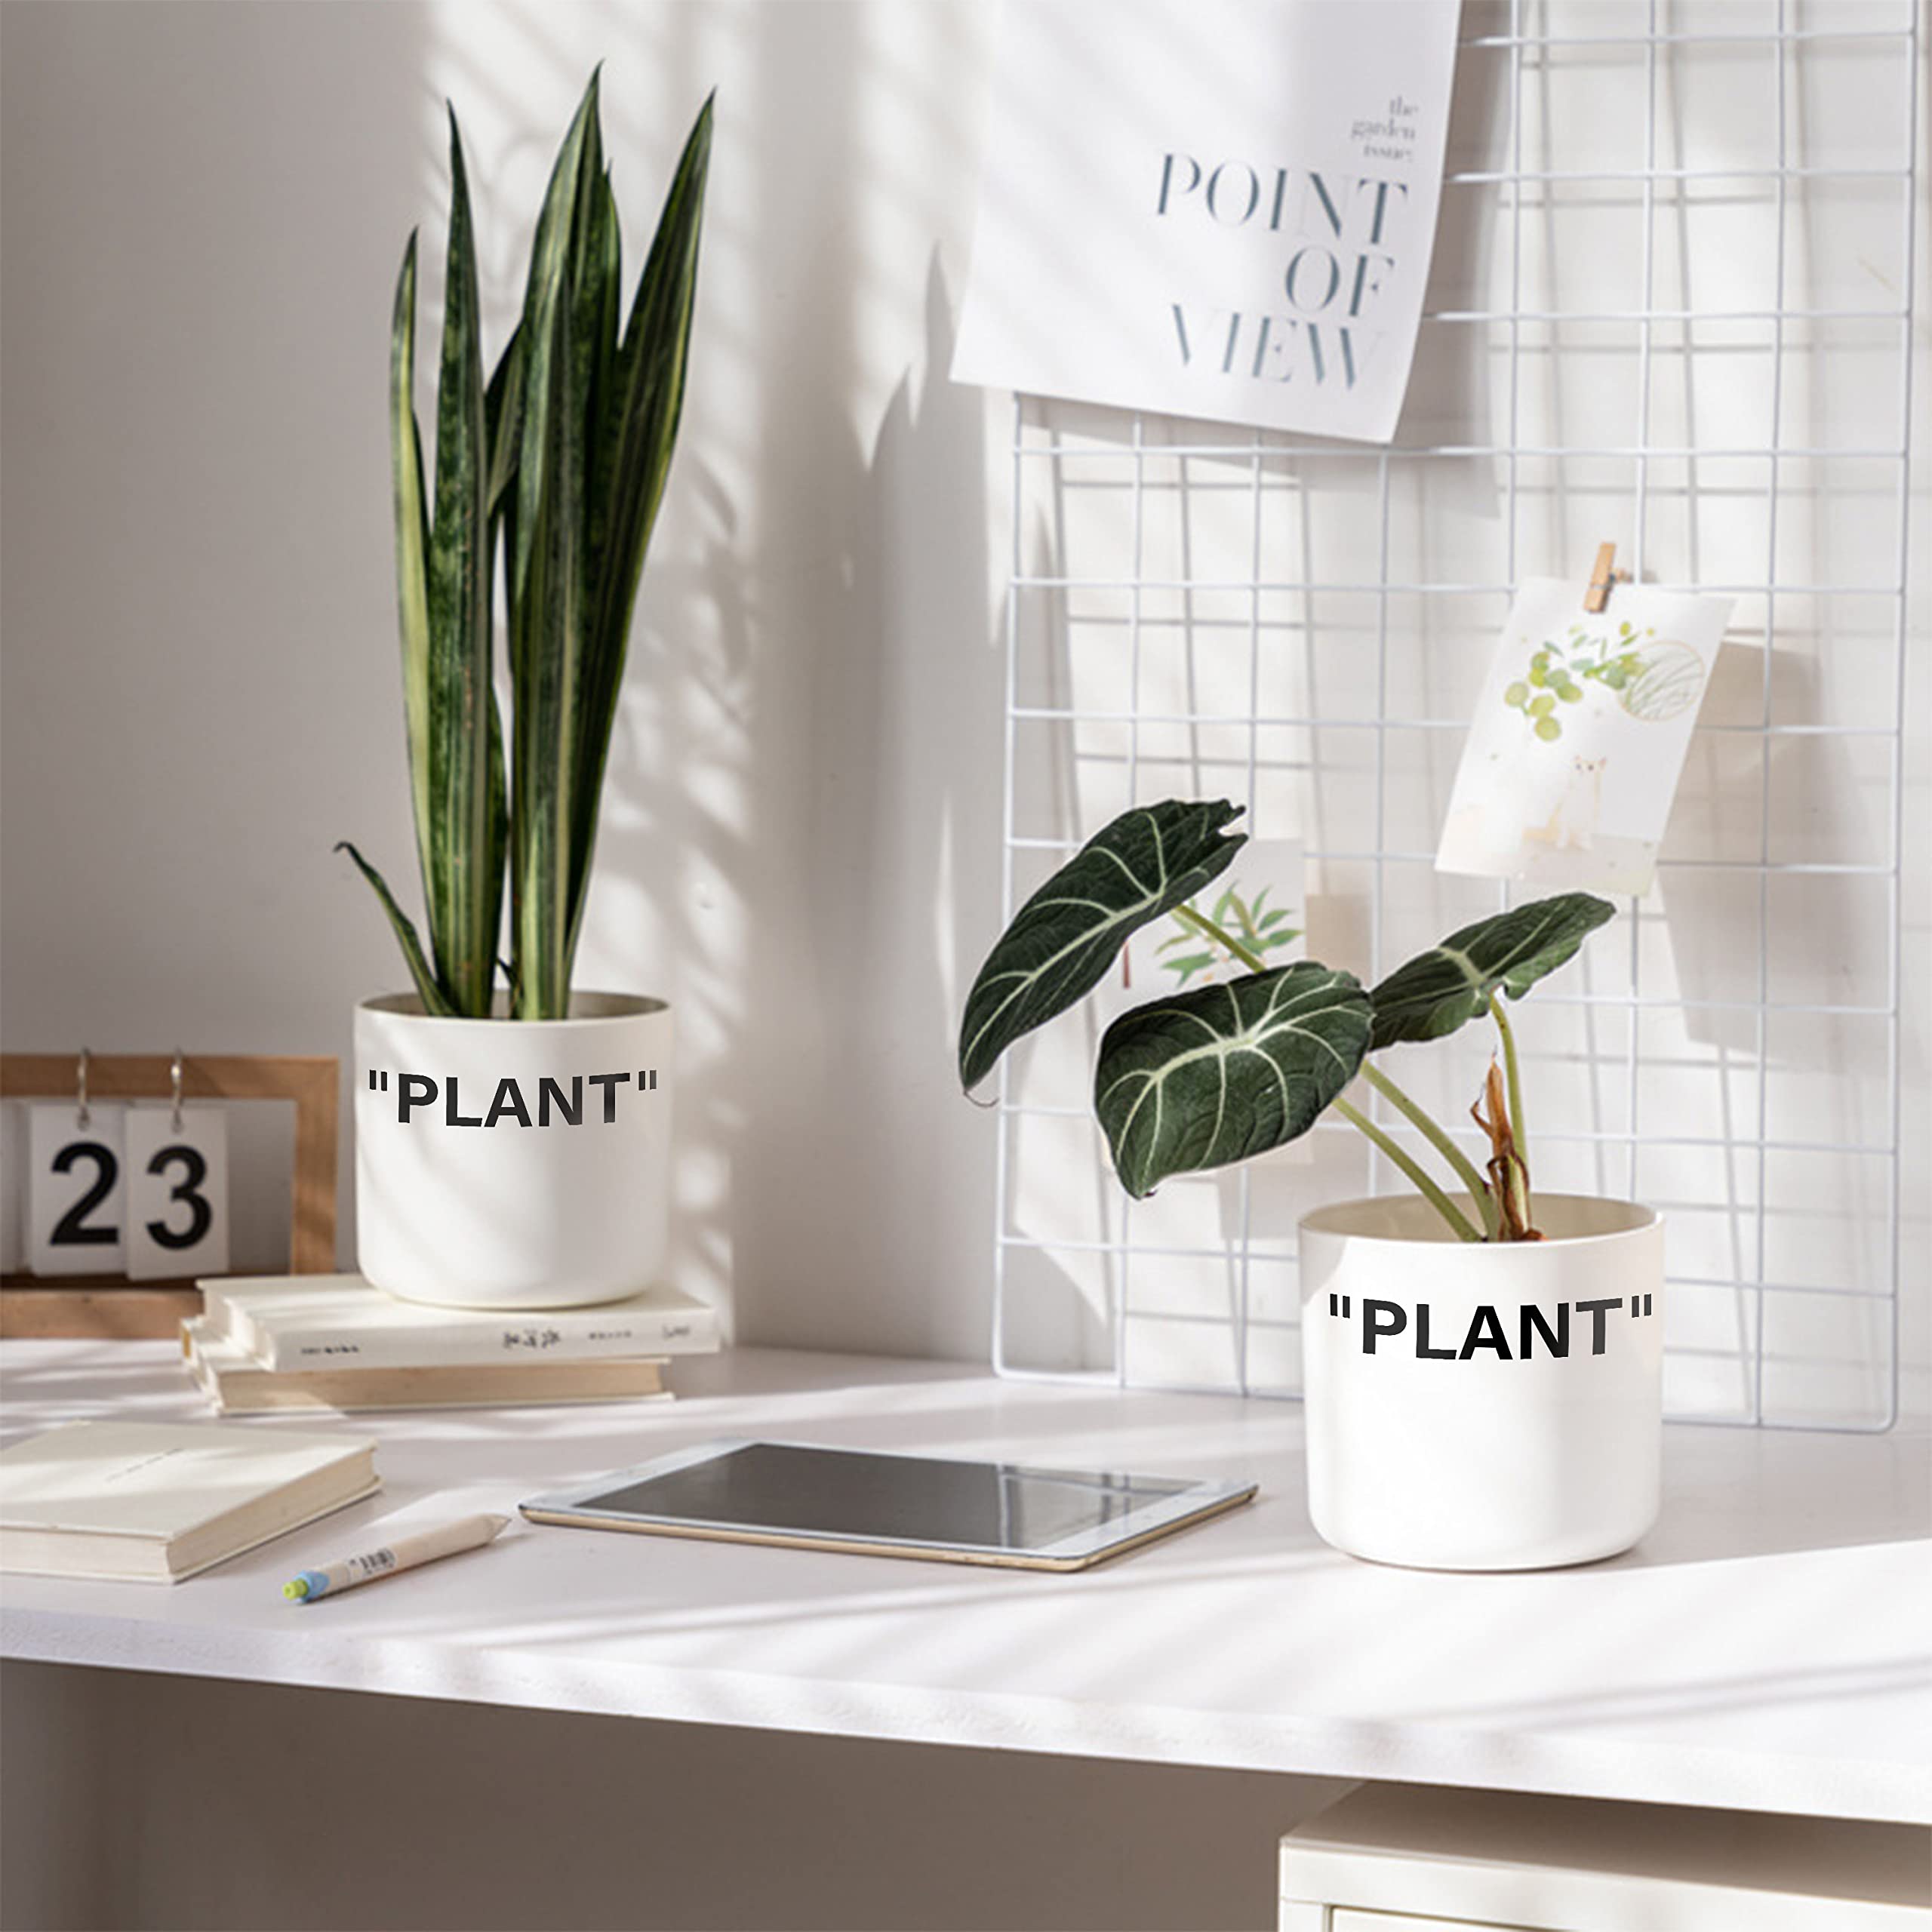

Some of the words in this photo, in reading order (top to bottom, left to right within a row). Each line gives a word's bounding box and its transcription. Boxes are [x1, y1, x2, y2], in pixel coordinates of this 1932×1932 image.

[1389, 95, 1419, 115] the
[1158, 153, 1408, 245] POINT
[1285, 246, 1395, 318] OF
[1172, 303, 1387, 389] VIEW
